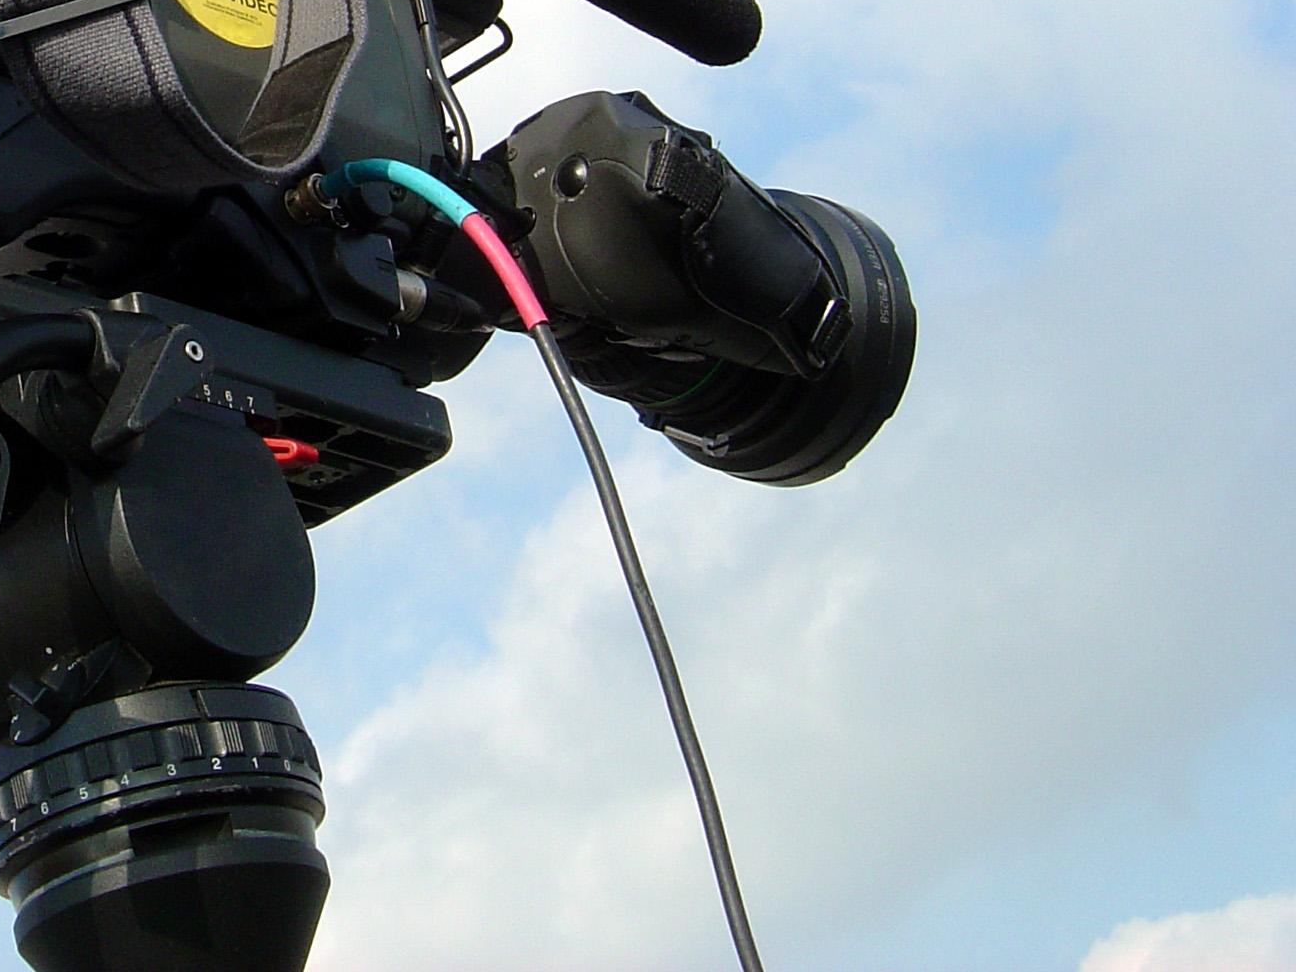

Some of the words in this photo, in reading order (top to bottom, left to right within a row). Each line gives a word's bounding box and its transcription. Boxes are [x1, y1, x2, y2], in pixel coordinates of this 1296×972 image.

[203, 384, 211, 397] 5
[225, 390, 233, 402] 6
[246, 395, 254, 408] 7
[40, 801, 49, 815] 6
[79, 787, 89, 800] 5
[120, 774, 130, 786] 4
[166, 763, 177, 776] 3
[211, 757, 223, 770] 2
[251, 756, 259, 769] 1
[283, 759, 292, 772] 0
